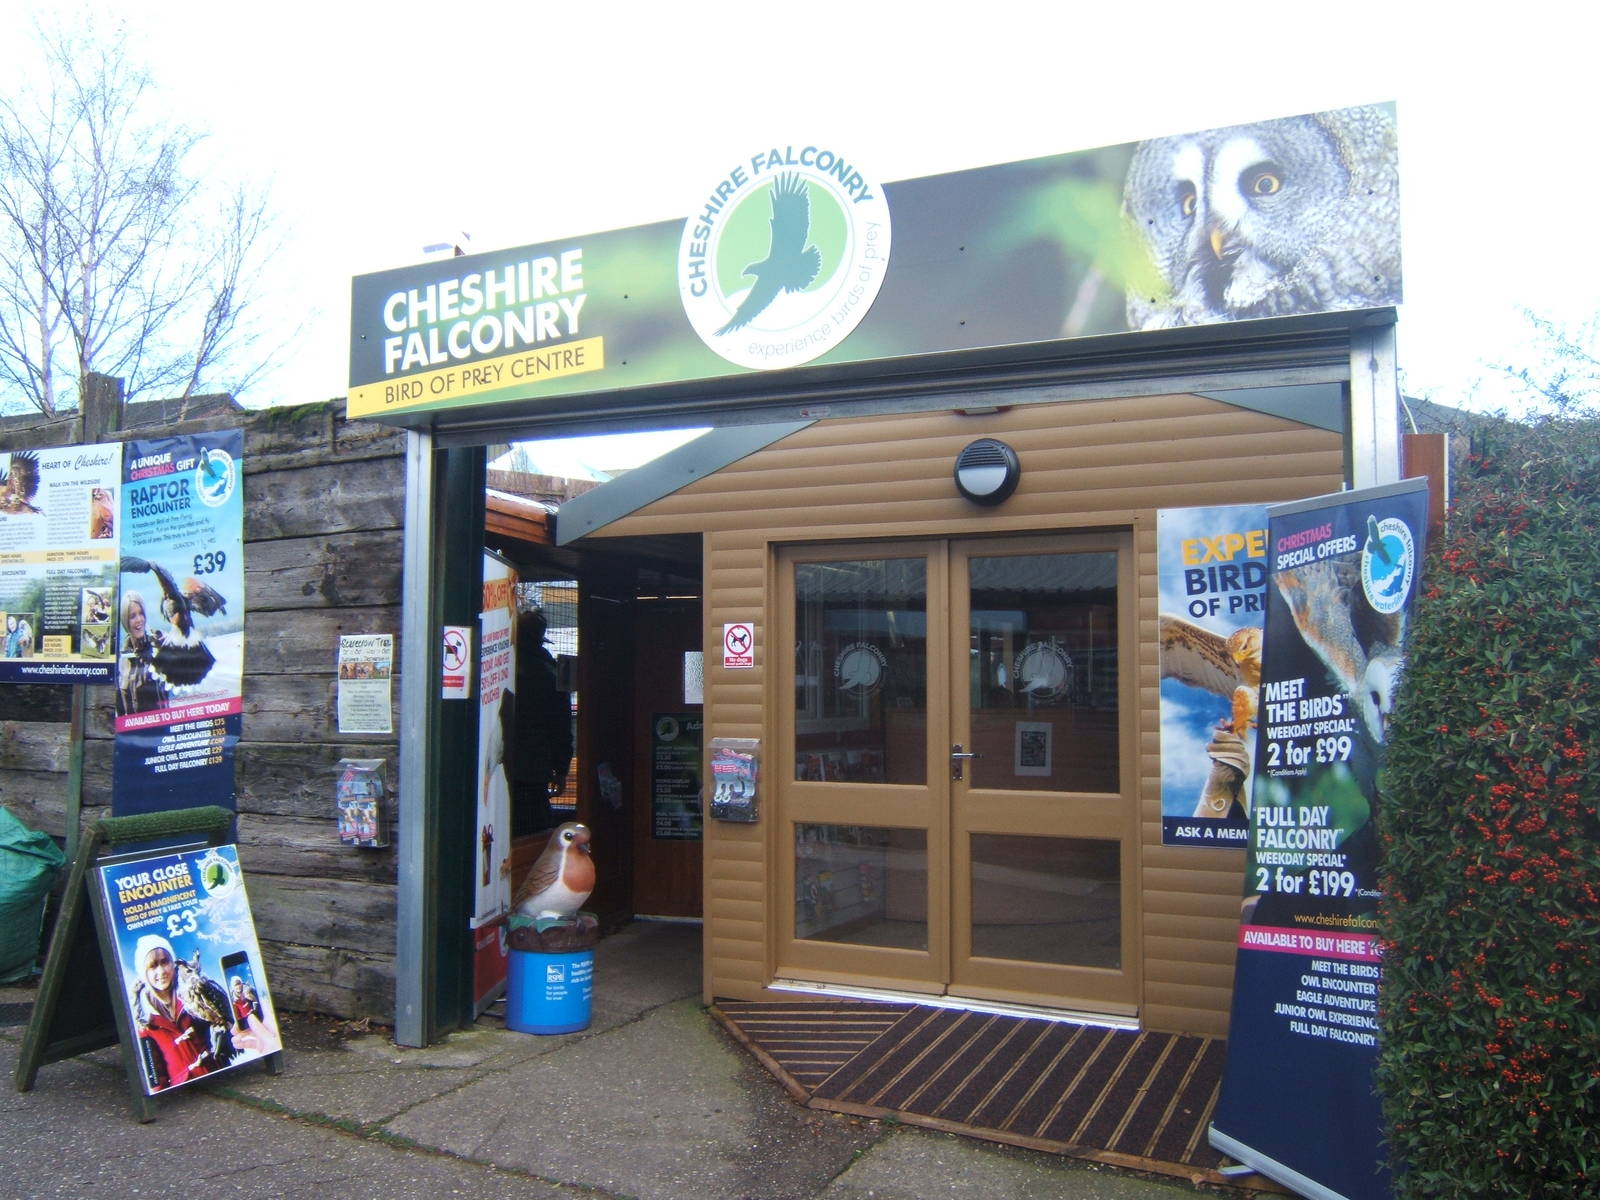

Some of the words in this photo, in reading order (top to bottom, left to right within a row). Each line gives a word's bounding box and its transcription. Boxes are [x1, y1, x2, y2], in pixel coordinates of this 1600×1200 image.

[689, 165, 749, 297] CHESHIRE
[751, 145, 874, 204] FALCONRY
[864, 222, 881, 259] prey
[859, 265, 872, 282] of
[383, 247, 584, 333] CHESHIRE
[833, 287, 864, 324] birds
[384, 293, 587, 374] FALCONRY
[748, 323, 832, 360] experience
[385, 380, 423, 404] BIRD
[430, 373, 454, 394] OF
[462, 363, 504, 389] PREY
[511, 346, 584, 378] CENTRE
[42, 461, 60, 470] HEART
[63, 460, 71, 468] OF
[74, 453, 114, 470] Cheshire!
[130, 463, 175, 480] CHRISTMAS
[176, 458, 195, 471] GIFT
[138, 453, 171, 468] UNIQUE
[130, 478, 190, 506] RAPTOR
[131, 497, 191, 519] ENCOUNTER
[1277, 523, 1332, 552] CHRISTMAS
[1381, 522, 1407, 538] cheshire
[193, 550, 227, 575] £39
[1276, 548, 1316, 570] SPECIAL
[1317, 535, 1356, 559] OFFERS
[1189, 597, 1220, 618] OF
[21, 664, 108, 677] www.cheshirefalconry.com
[125, 714, 160, 727] AVAILABLE
[161, 713, 170, 721] TO
[171, 710, 186, 720] BUY
[187, 706, 204, 717] HERE
[205, 702, 230, 714] TODAY
[1266, 701, 1296, 723] THE
[162, 735, 176, 743] OWL
[177, 730, 211, 742] ENCOUNTER
[170, 725, 184, 733] MEET
[185, 722, 195, 730] THE
[196, 720, 213, 729] BIRDS
[1267, 723, 1312, 740] WEEKDAY
[175, 739, 210, 750] ADVENTURE
[1267, 743, 1280, 766] 2
[1285, 740, 1311, 765] for
[1316, 736, 1351, 763] £99
[144, 755, 165, 765] JUNIOR
[166, 753, 178, 761] OWL
[179, 747, 211, 760] EXPERIENCE
[155, 765, 167, 773] FULL
[168, 762, 179, 771] DAY
[180, 758, 208, 769] FALCONRY
[1300, 806, 1328, 826] DAY
[1175, 826, 1201, 838] ASK
[1204, 828, 1214, 838] A
[1256, 851, 1305, 867] WEEKDAY
[114, 872, 151, 890] YOUR
[152, 863, 189, 881] CLOSE
[1256, 868, 1269, 891] 2
[1275, 867, 1303, 893] for
[1308, 870, 1355, 897] £199
[119, 874, 193, 904] ENCOUNTER
[123, 904, 143, 916] HOLD
[144, 902, 150, 910] A
[151, 890, 196, 907] MAGNIFICENT
[125, 915, 139, 924] BIRD
[148, 909, 161, 917] PREY
[167, 903, 182, 911] TAKE
[182, 898, 198, 907] YOUR
[127, 922, 144, 931] OWN
[144, 915, 163, 926] PHOTO
[167, 910, 197, 938] £3
[1244, 931, 1297, 948] AVAILABLE
[1300, 936, 1313, 950] TO
[1315, 938, 1334, 952] BUY
[1336, 940, 1365, 955] HERE
[1311, 960, 1332, 973] MEET
[1333, 962, 1348, 975] THE
[1350, 964, 1379, 978] BIRDS
[1301, 975, 1320, 987] OWL
[1322, 978, 1375, 995] ENCOUNTER
[1297, 990, 1322, 1004] EAGLE
[1324, 994, 1376, 1011] ADVENTURE
[1274, 1003, 1306, 1018] JUNIOR
[1308, 1008, 1327, 1022] OWL
[1290, 1021, 1309, 1035] FULL
[1311, 1024, 1327, 1037] DAY
[1329, 1028, 1375, 1046] FALCONRY
